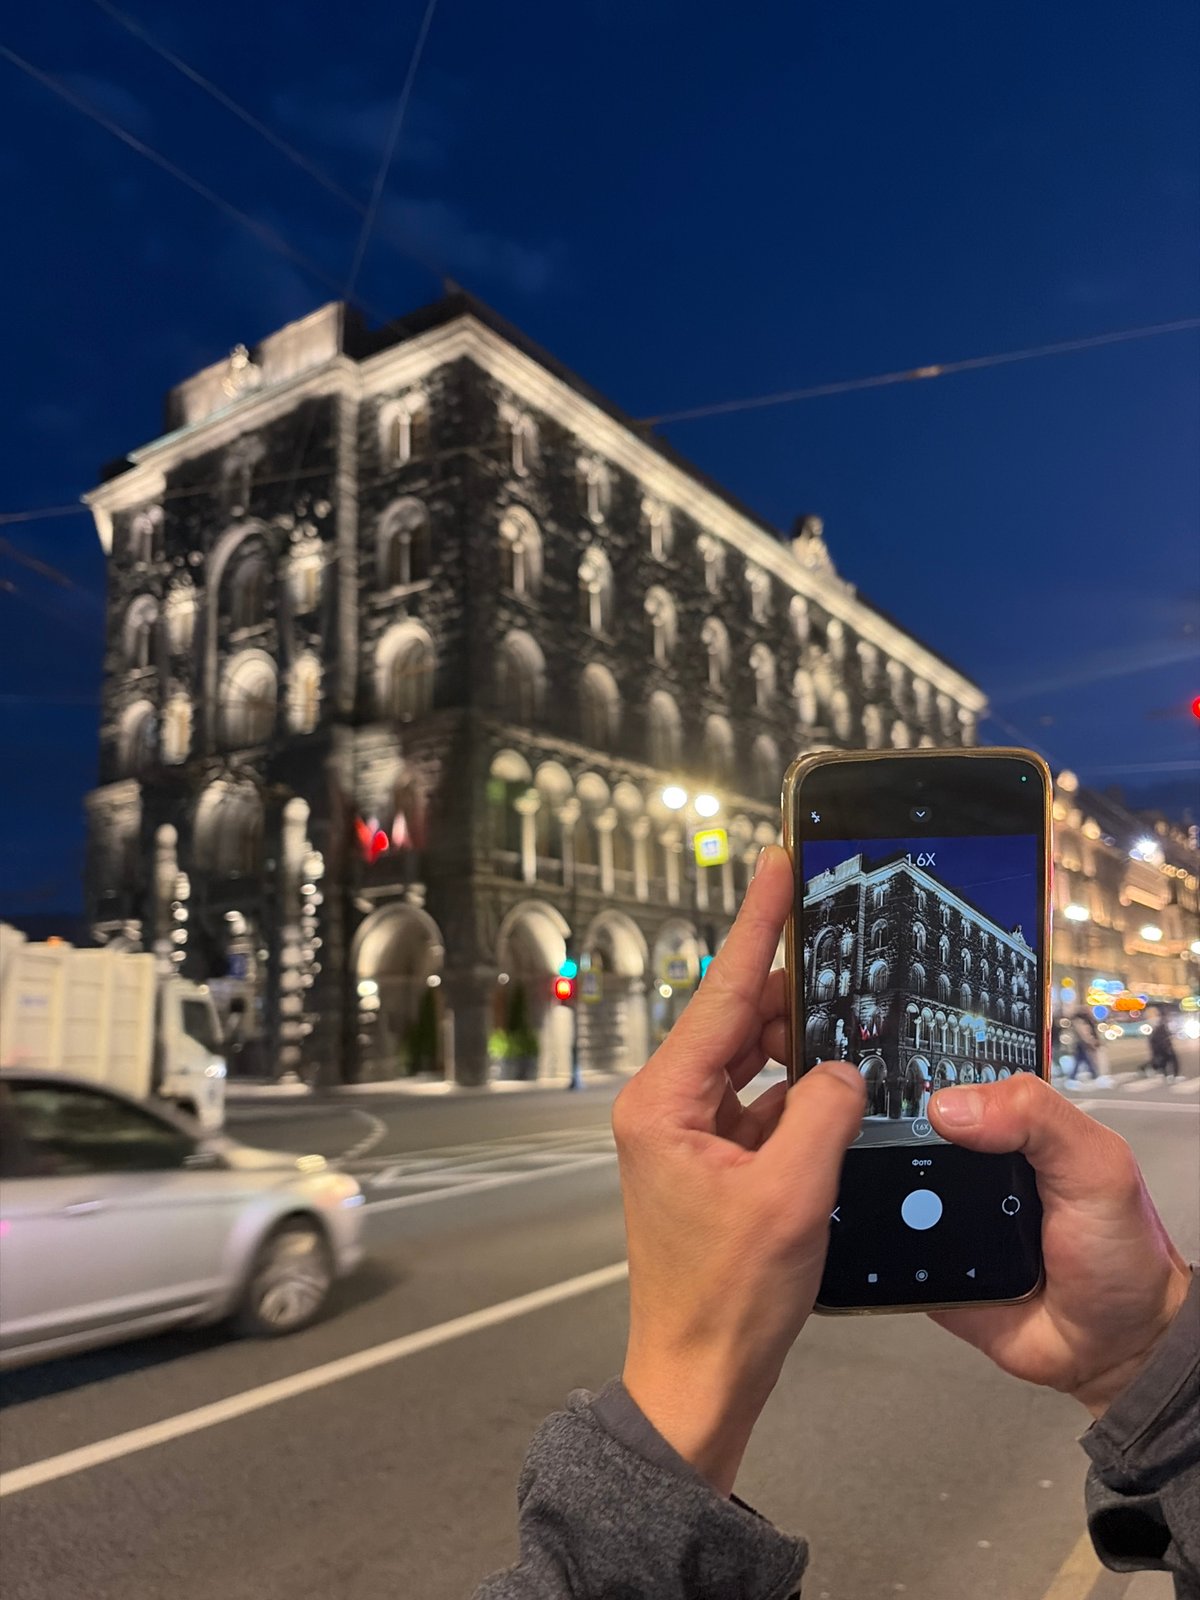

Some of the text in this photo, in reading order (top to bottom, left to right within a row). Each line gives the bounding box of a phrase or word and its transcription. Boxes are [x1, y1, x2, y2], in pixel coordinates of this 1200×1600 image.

[906, 852, 936, 867] 1.6X
[915, 1123, 929, 1131] 1.6X
[912, 1159, 932, 1167] Фото
